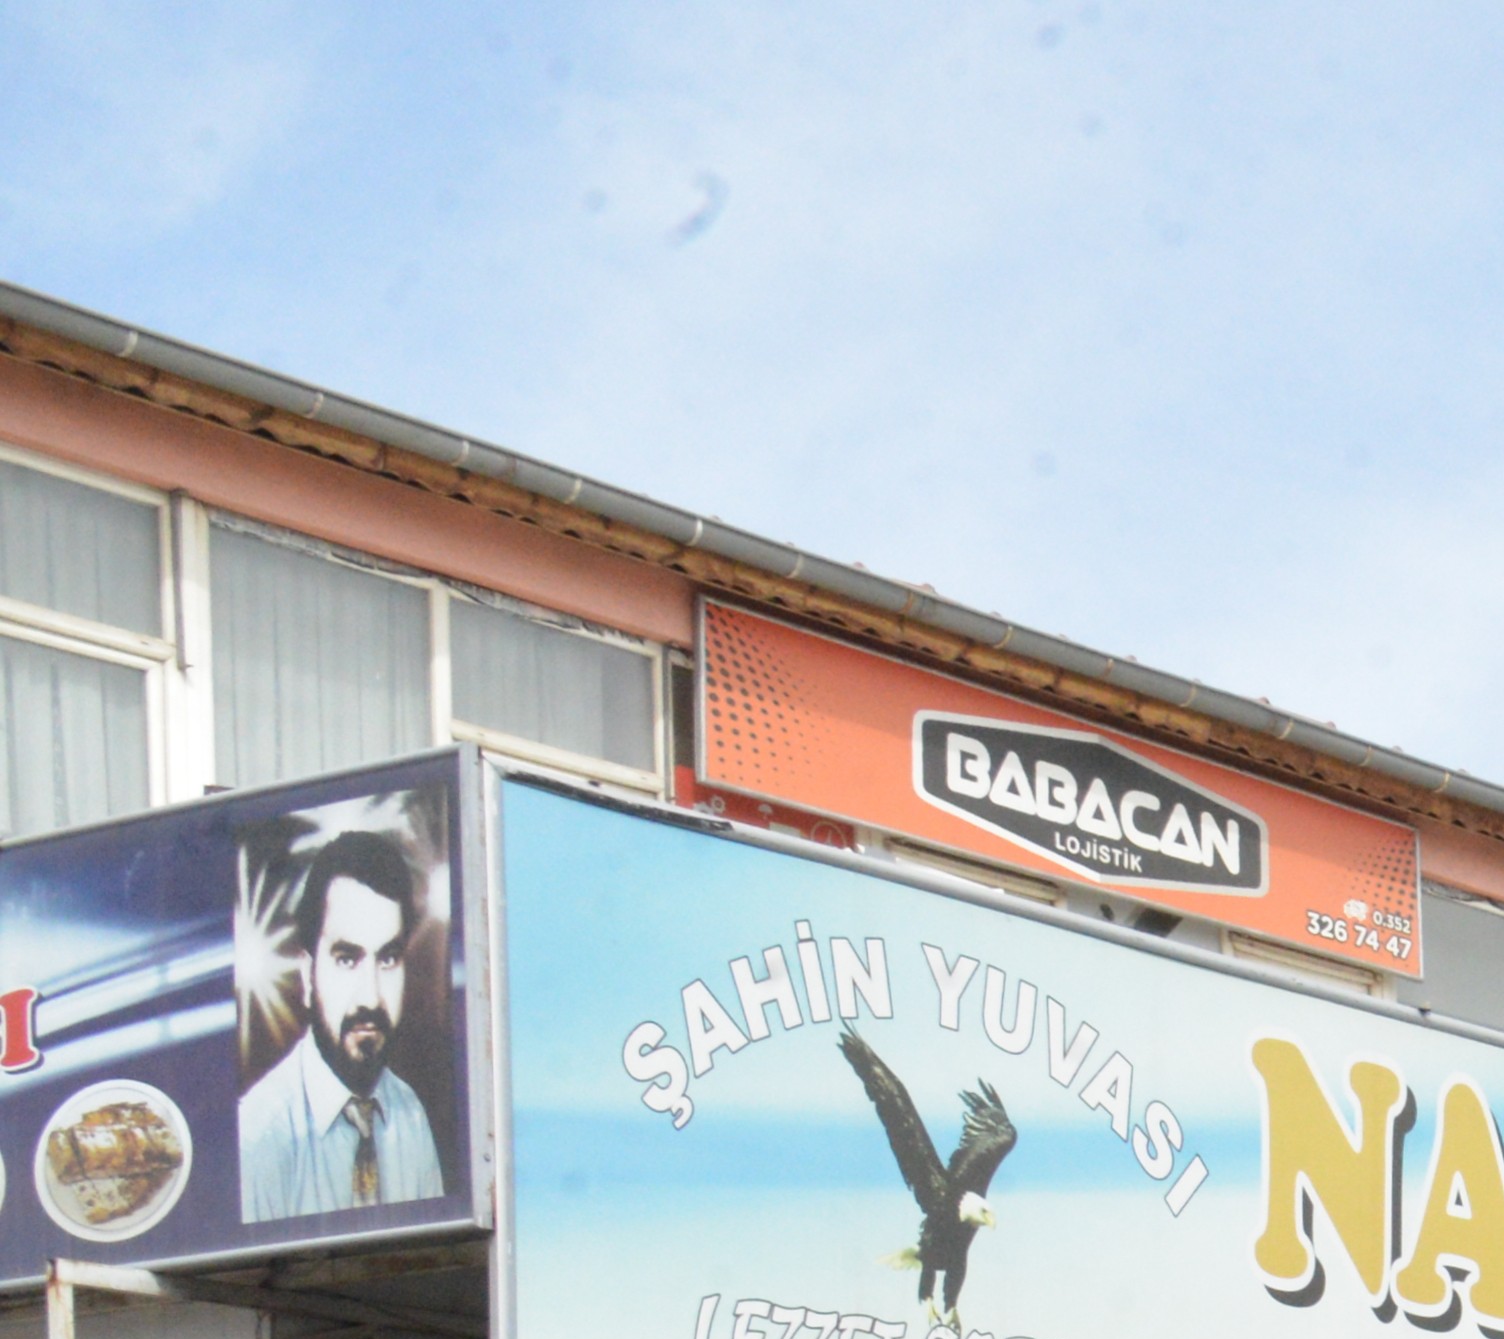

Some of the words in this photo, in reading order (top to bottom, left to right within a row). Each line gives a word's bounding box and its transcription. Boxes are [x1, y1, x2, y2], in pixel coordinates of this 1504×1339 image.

[946, 732, 1240, 875] BABACAN
[1053, 831, 1143, 874] LOJİSTİK
[1306, 911, 1348, 942] 326
[1354, 924, 1379, 952] 74
[1386, 935, 1412, 959] 47
[1372, 910, 1411, 935] 0.352
[622, 919, 893, 1130] ŞAHİN
[921, 942, 1209, 1218] YUVASI
